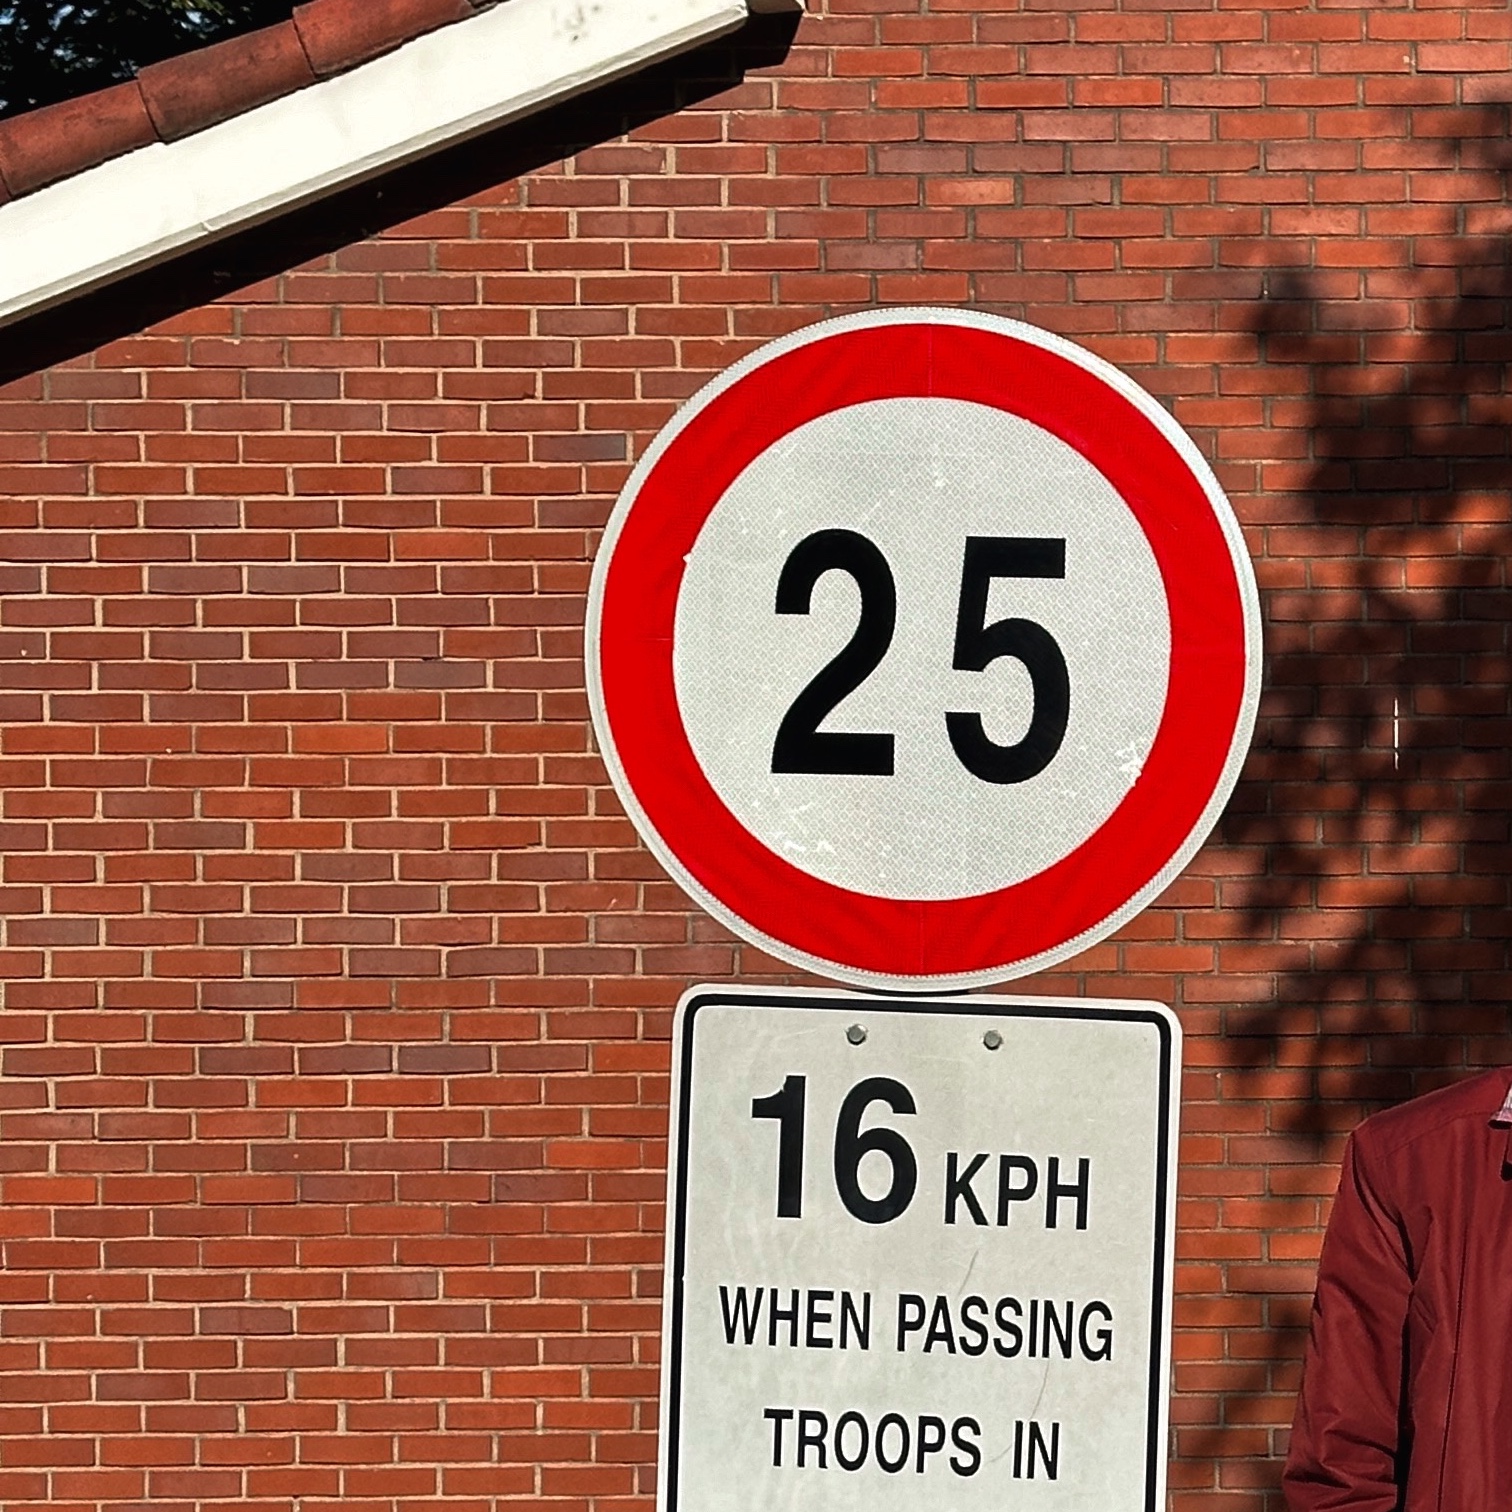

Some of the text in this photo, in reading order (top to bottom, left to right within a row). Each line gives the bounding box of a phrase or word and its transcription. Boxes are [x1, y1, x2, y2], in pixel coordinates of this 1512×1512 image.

[771, 528, 1071, 784] 25
[752, 1074, 1091, 1231] 16 KPH
[719, 1285, 1115, 1362] WHEN PASSING
[764, 1408, 1061, 1481] TROOPS IN
